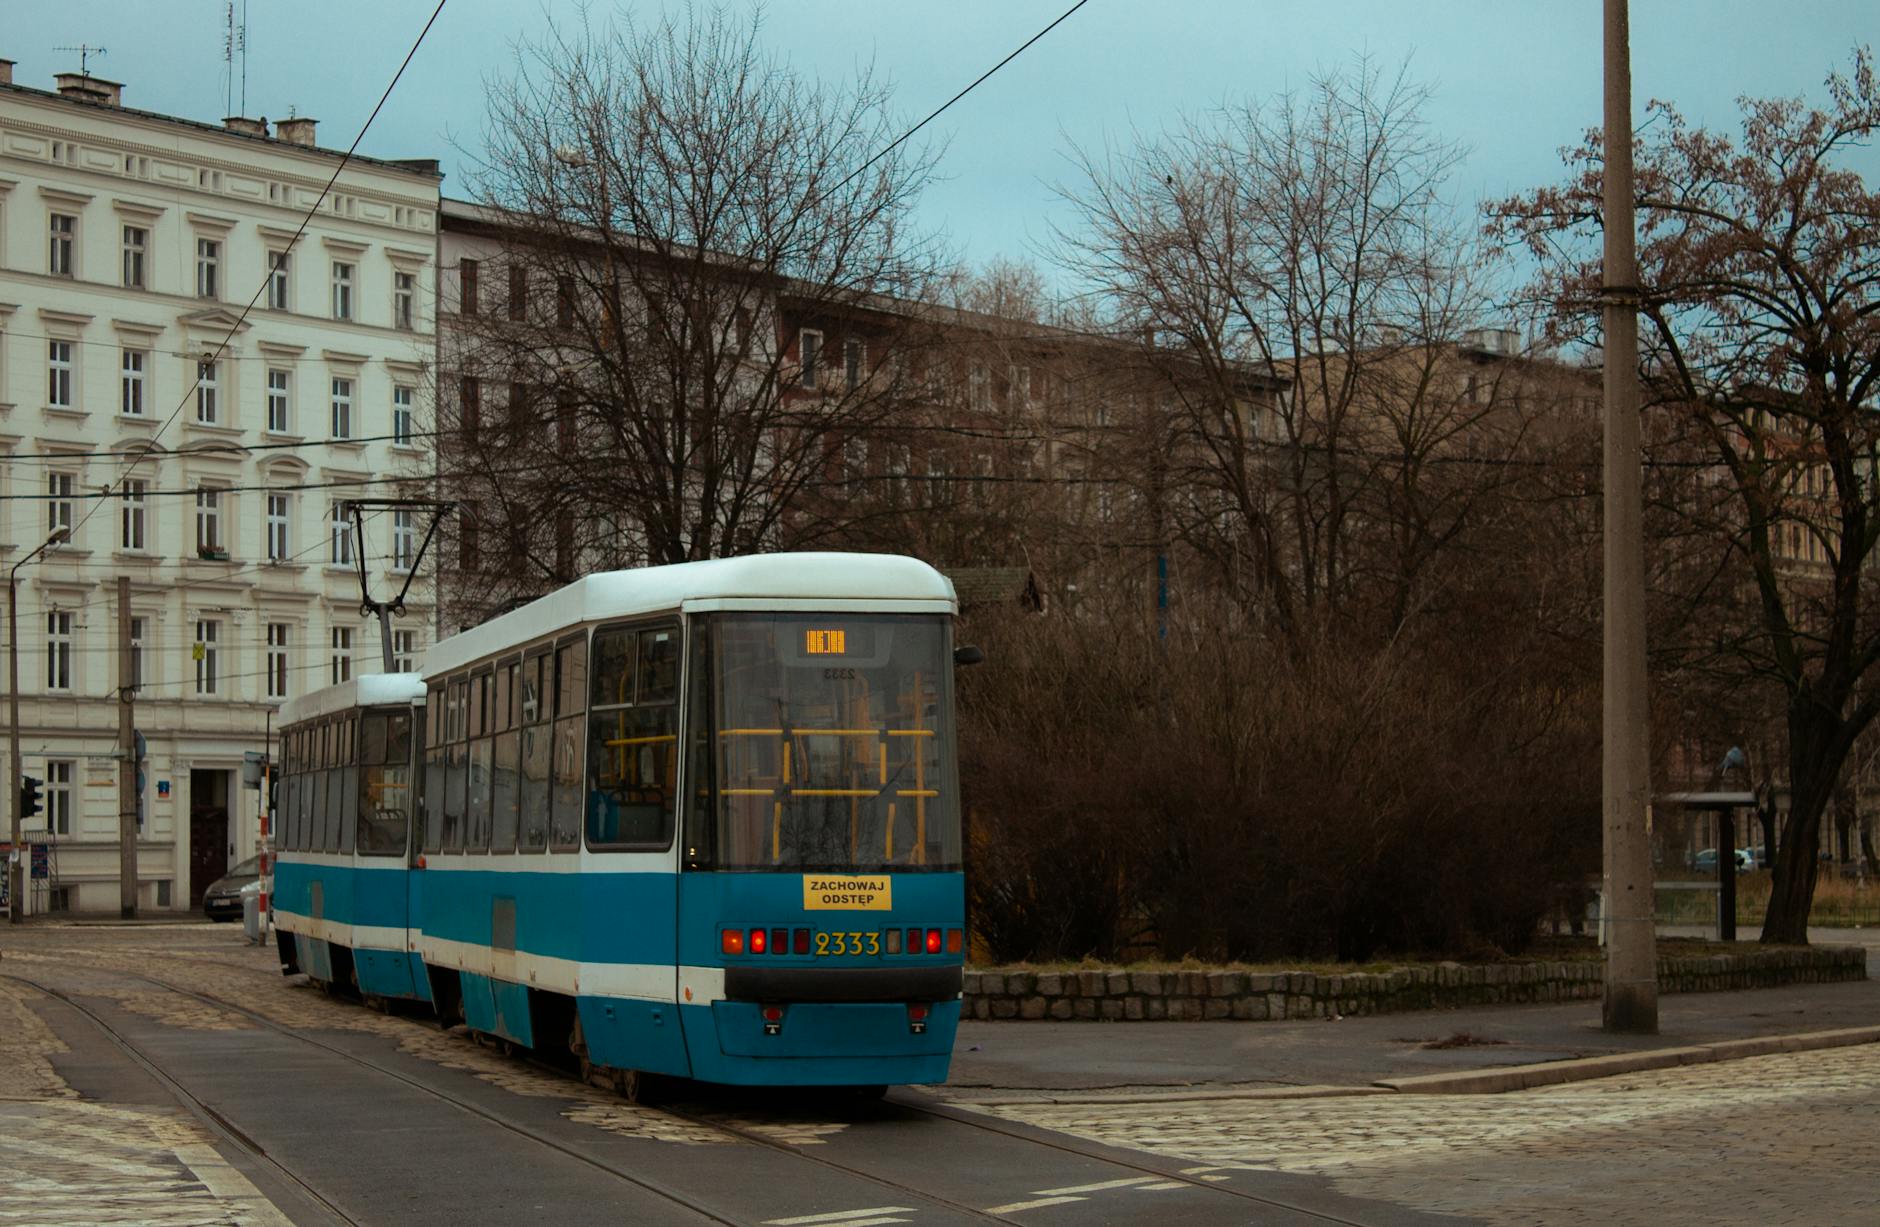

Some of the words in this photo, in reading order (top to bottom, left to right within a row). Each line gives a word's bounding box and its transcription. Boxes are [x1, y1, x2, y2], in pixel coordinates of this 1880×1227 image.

[811, 881, 885, 891] ZACHOWAJ
[822, 894, 874, 906] ODSTĘP
[815, 932, 880, 955] 2333
